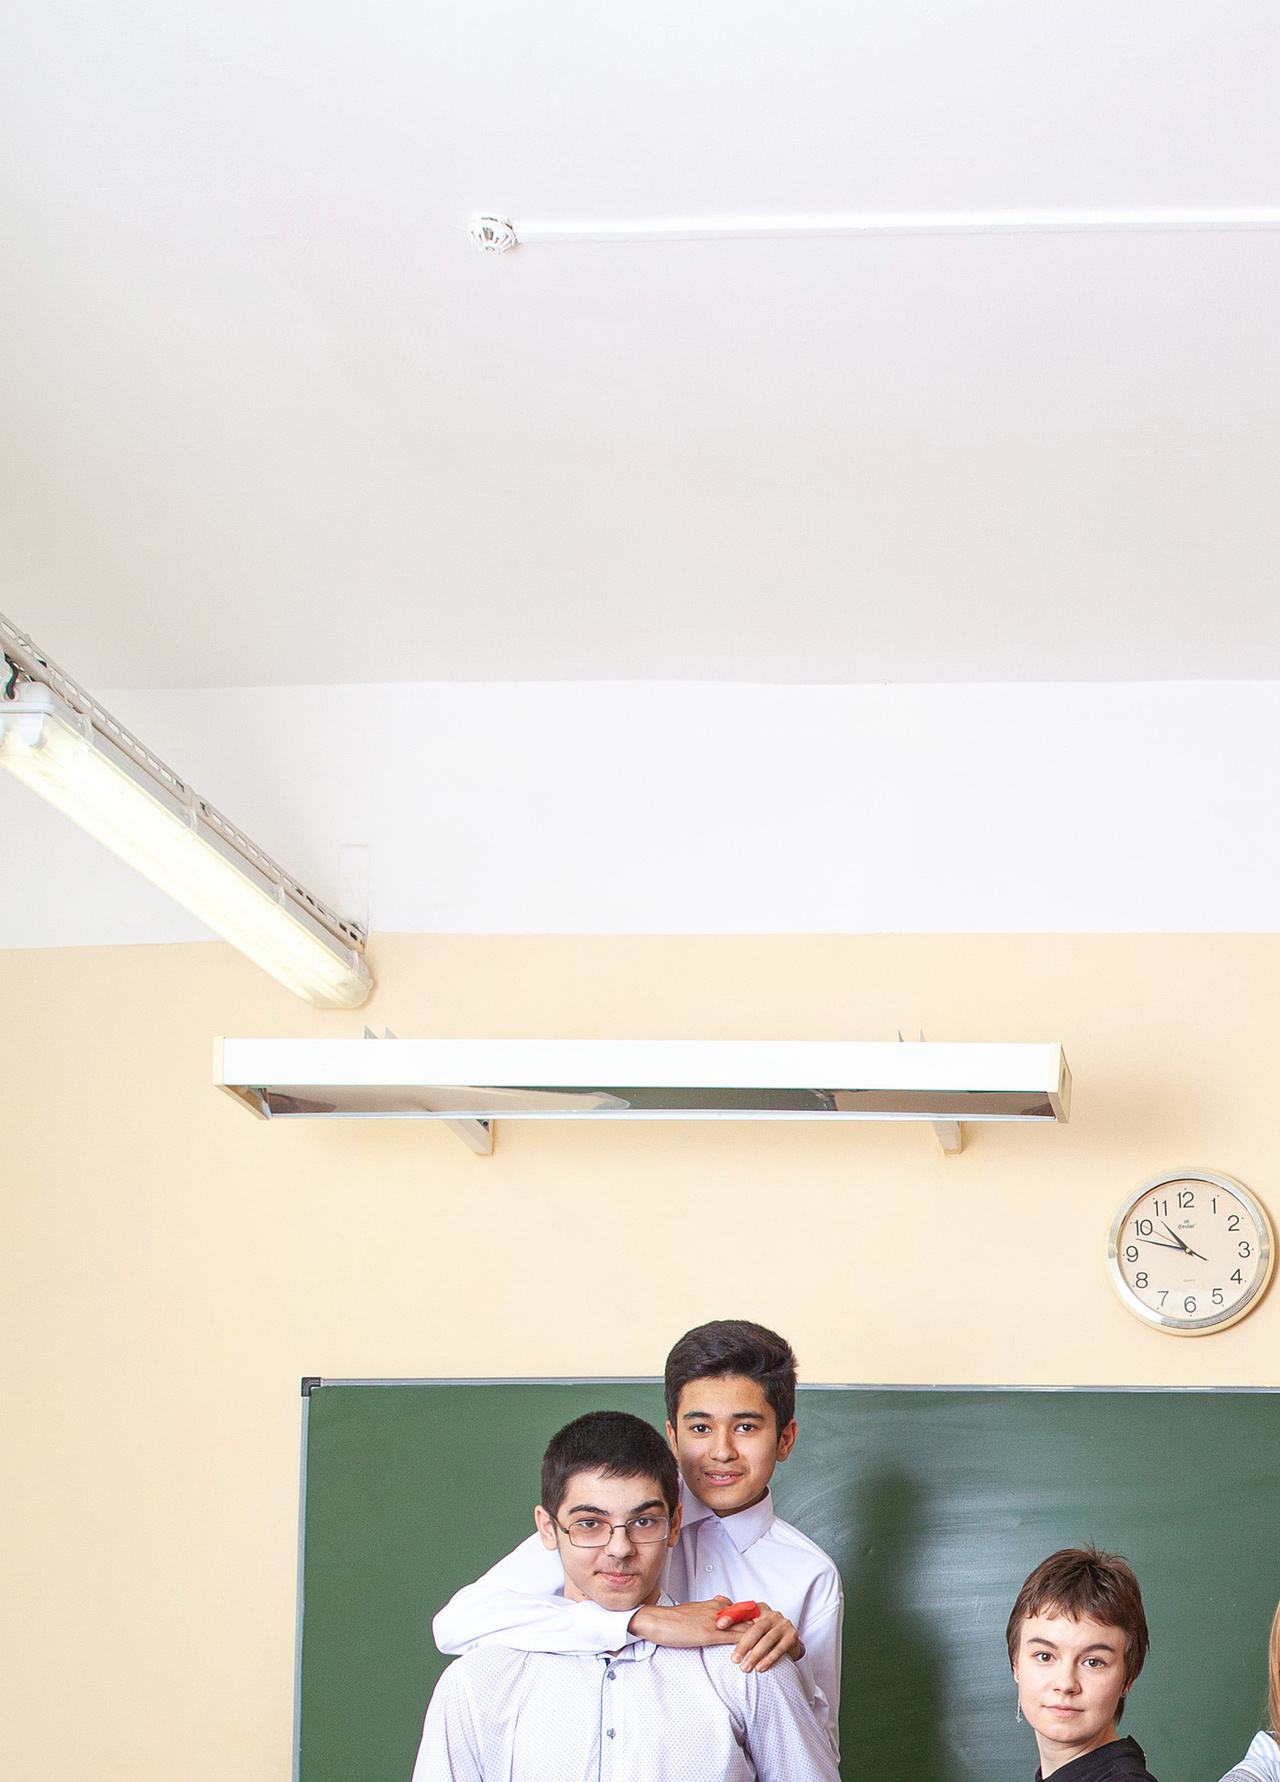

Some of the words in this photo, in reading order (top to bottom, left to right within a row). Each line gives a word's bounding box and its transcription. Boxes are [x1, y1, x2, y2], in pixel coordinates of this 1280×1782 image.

[1154, 1200, 1167, 1216] 11
[1177, 1192, 1195, 1208] 12
[1212, 1198, 1216, 1214] 1
[1134, 1220, 1153, 1236] 10
[1228, 1215, 1240, 1232] 2
[1126, 1246, 1139, 1262] 9
[1238, 1241, 1250, 1258] 3
[1136, 1272, 1148, 1288] 8
[1230, 1269, 1242, 1284] 4
[1158, 1291, 1169, 1306] 7
[1184, 1296, 1197, 1313] 6
[1212, 1289, 1223, 1304] 5
